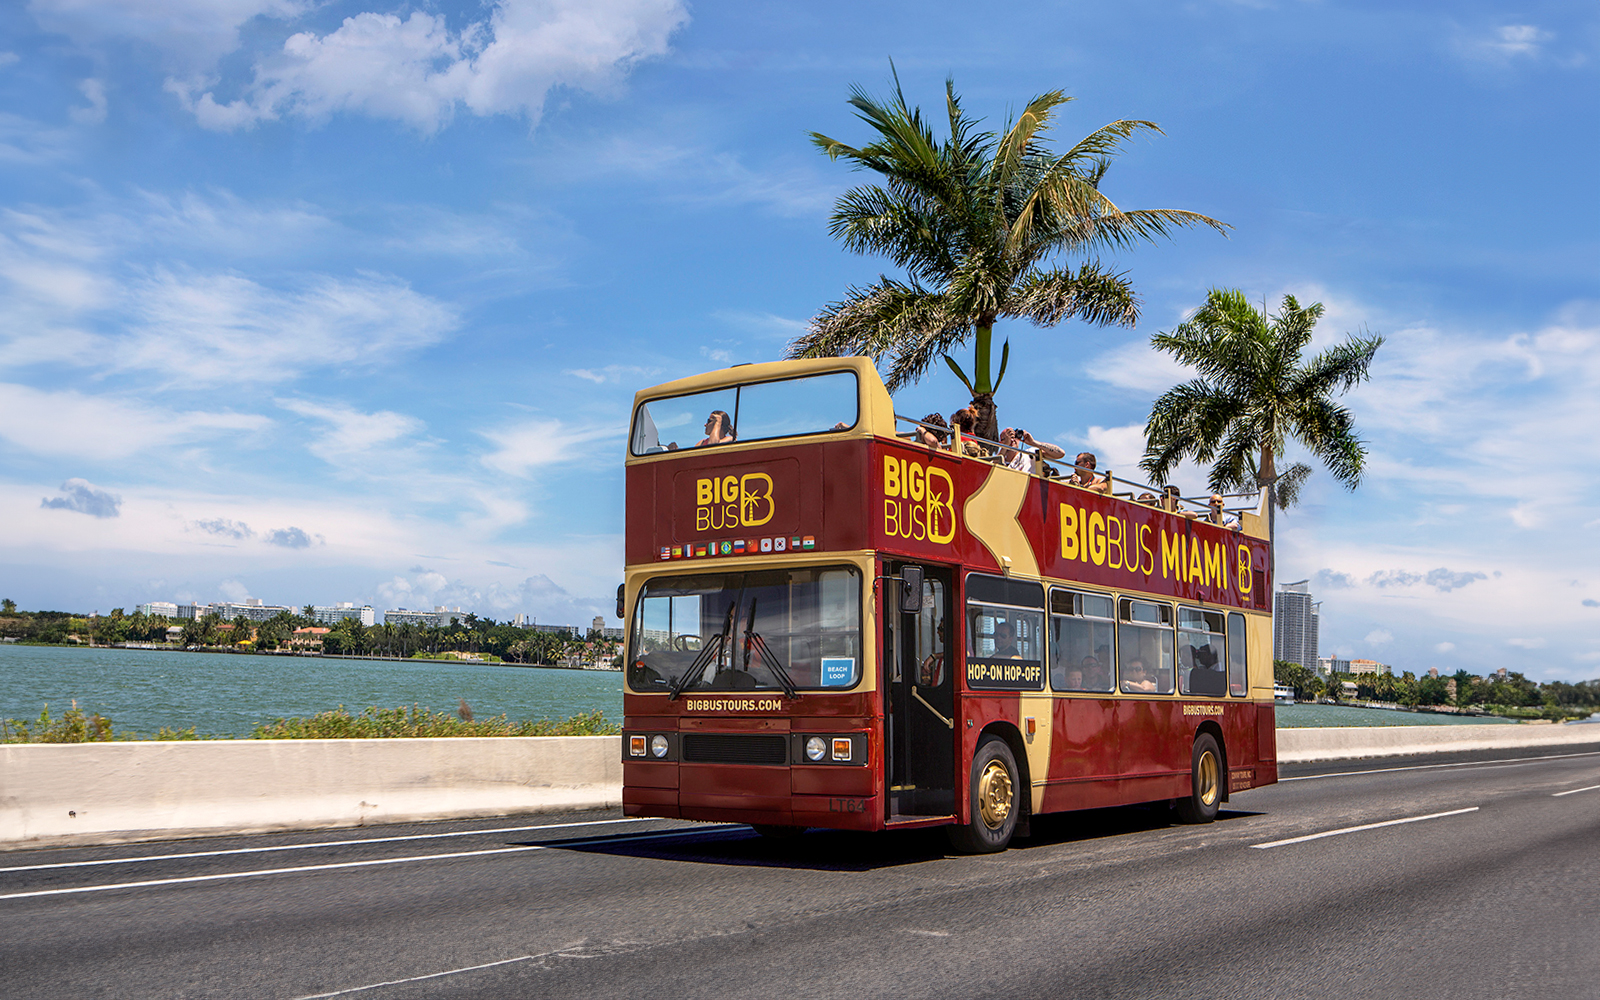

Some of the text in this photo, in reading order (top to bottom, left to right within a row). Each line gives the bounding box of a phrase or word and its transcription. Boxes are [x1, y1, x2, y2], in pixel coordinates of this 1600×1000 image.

[697, 475, 739, 505] BIG
[883, 455, 925, 501] BIG
[696, 504, 739, 531] BUS
[884, 499, 925, 541] BUS
[1161, 529, 1228, 590] MIAMI
[967, 663, 1041, 682] HOP-ON HOP-OFF
[686, 699, 782, 711] BIGBUSTOURS.COM
[1183, 704, 1224, 716] BIGBUSTOURS.COM
[829, 797, 866, 813] LT64
